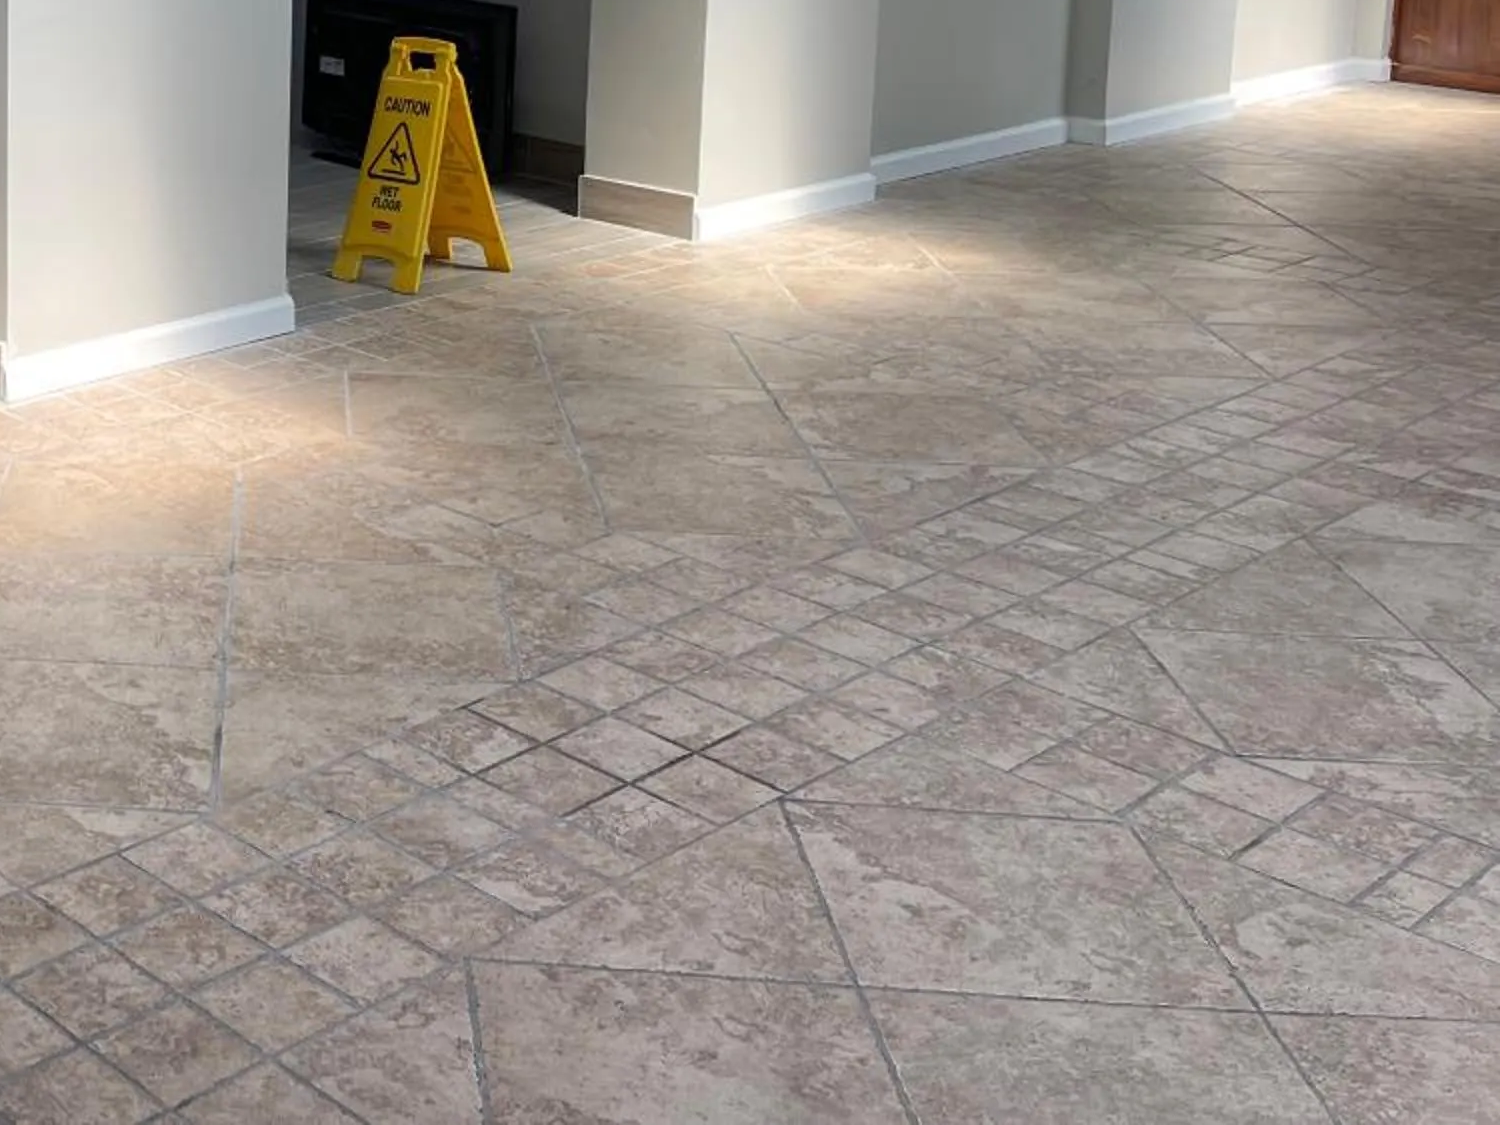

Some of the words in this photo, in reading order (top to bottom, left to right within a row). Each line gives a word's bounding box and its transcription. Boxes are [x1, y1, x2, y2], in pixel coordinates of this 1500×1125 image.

[384, 96, 431, 117] CAUTION
[379, 186, 400, 198] WET
[371, 196, 403, 212] FLOOR
